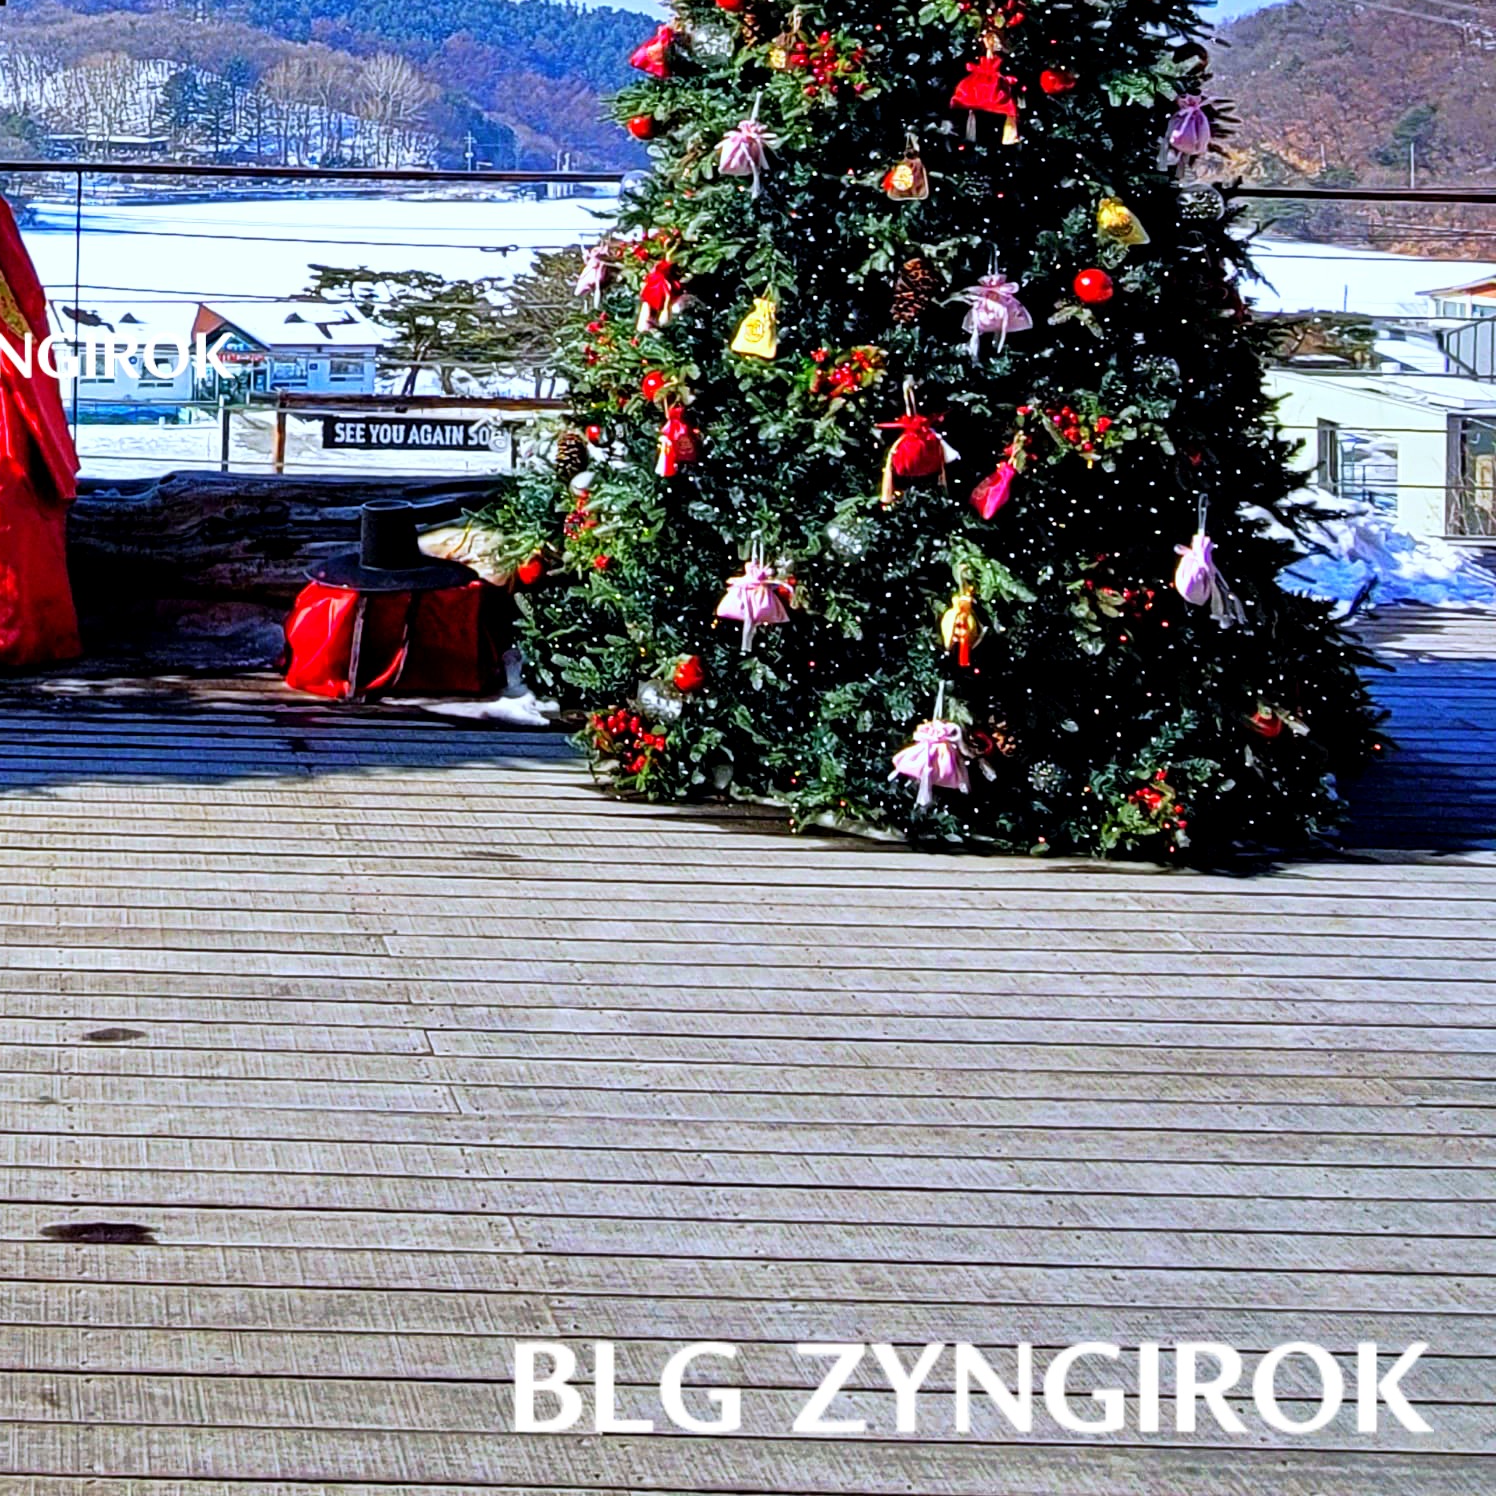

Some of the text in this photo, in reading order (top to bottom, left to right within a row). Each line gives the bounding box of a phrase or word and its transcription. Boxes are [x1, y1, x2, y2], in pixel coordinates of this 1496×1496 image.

[333, 422, 505, 447] SEE YOU AGAIN SO
